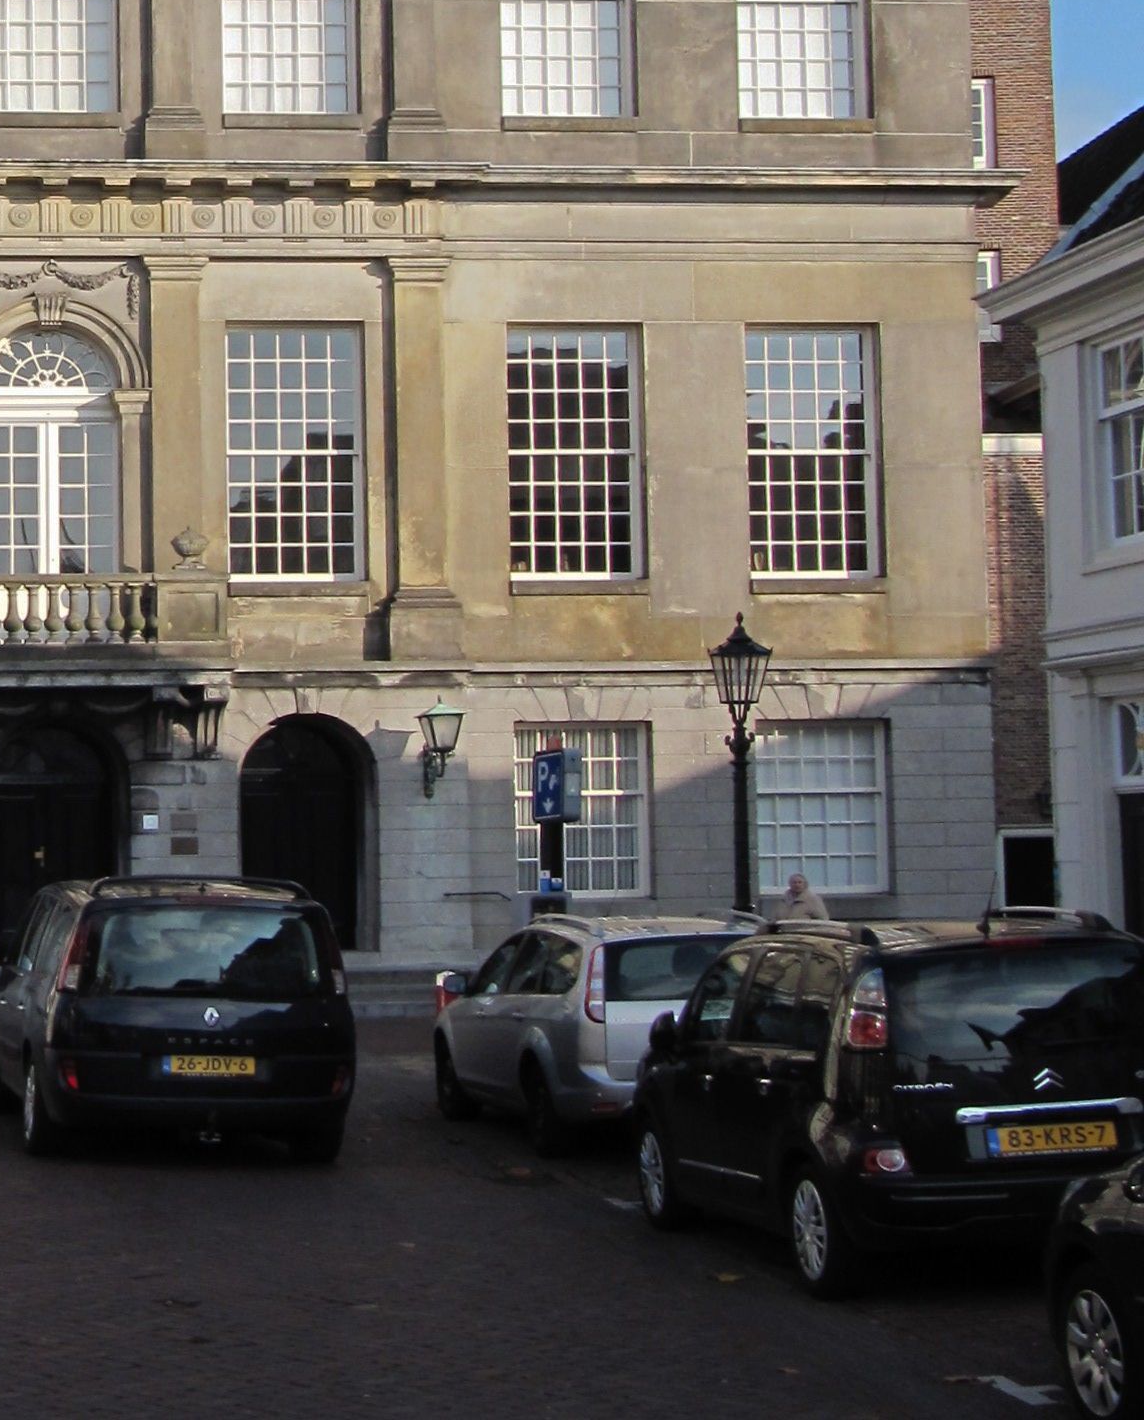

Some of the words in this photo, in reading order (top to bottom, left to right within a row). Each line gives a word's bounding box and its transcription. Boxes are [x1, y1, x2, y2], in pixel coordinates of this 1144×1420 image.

[537, 761, 549, 793] P
[167, 1037, 254, 1046] ESPACE
[176, 1057, 248, 1072] 26-JDV-6
[1007, 1125, 1105, 1148] 83-KRS-7
